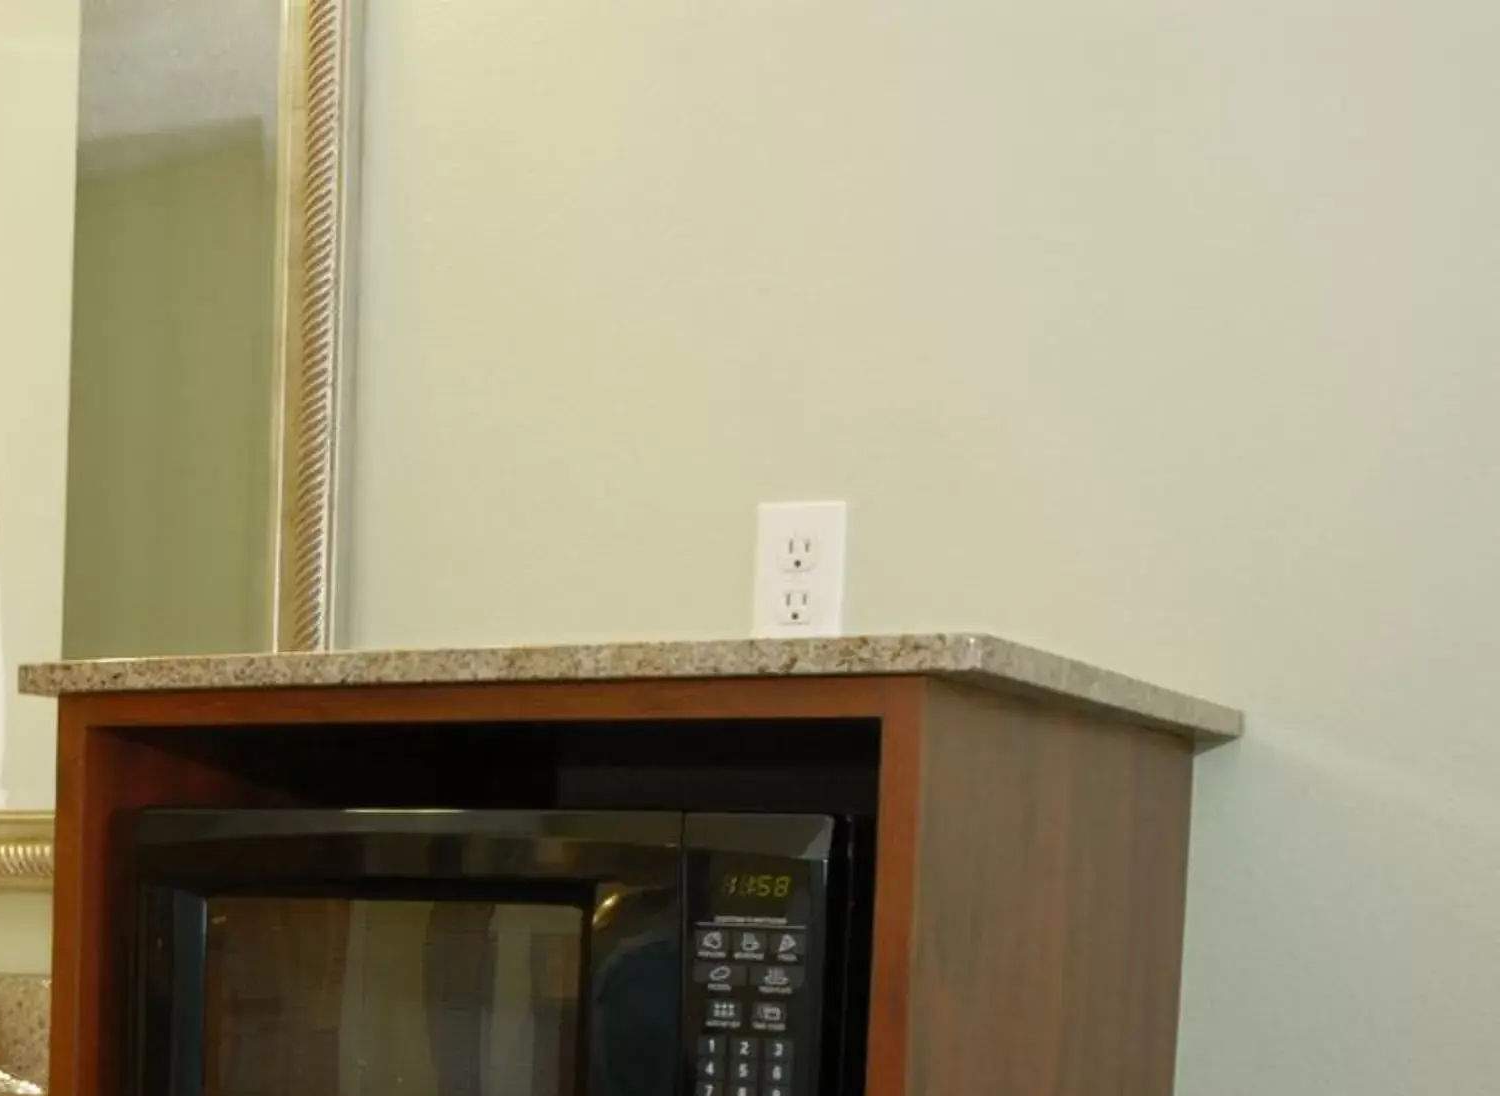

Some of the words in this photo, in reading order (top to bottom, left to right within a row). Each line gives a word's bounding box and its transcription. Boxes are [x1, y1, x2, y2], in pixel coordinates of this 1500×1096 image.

[708, 1038, 716, 1053] 1
[739, 1041, 750, 1056] 2
[774, 1042, 784, 1057] 3
[704, 1060, 715, 1076] 4
[738, 1063, 749, 1078] 5
[772, 1065, 782, 1081] 6
